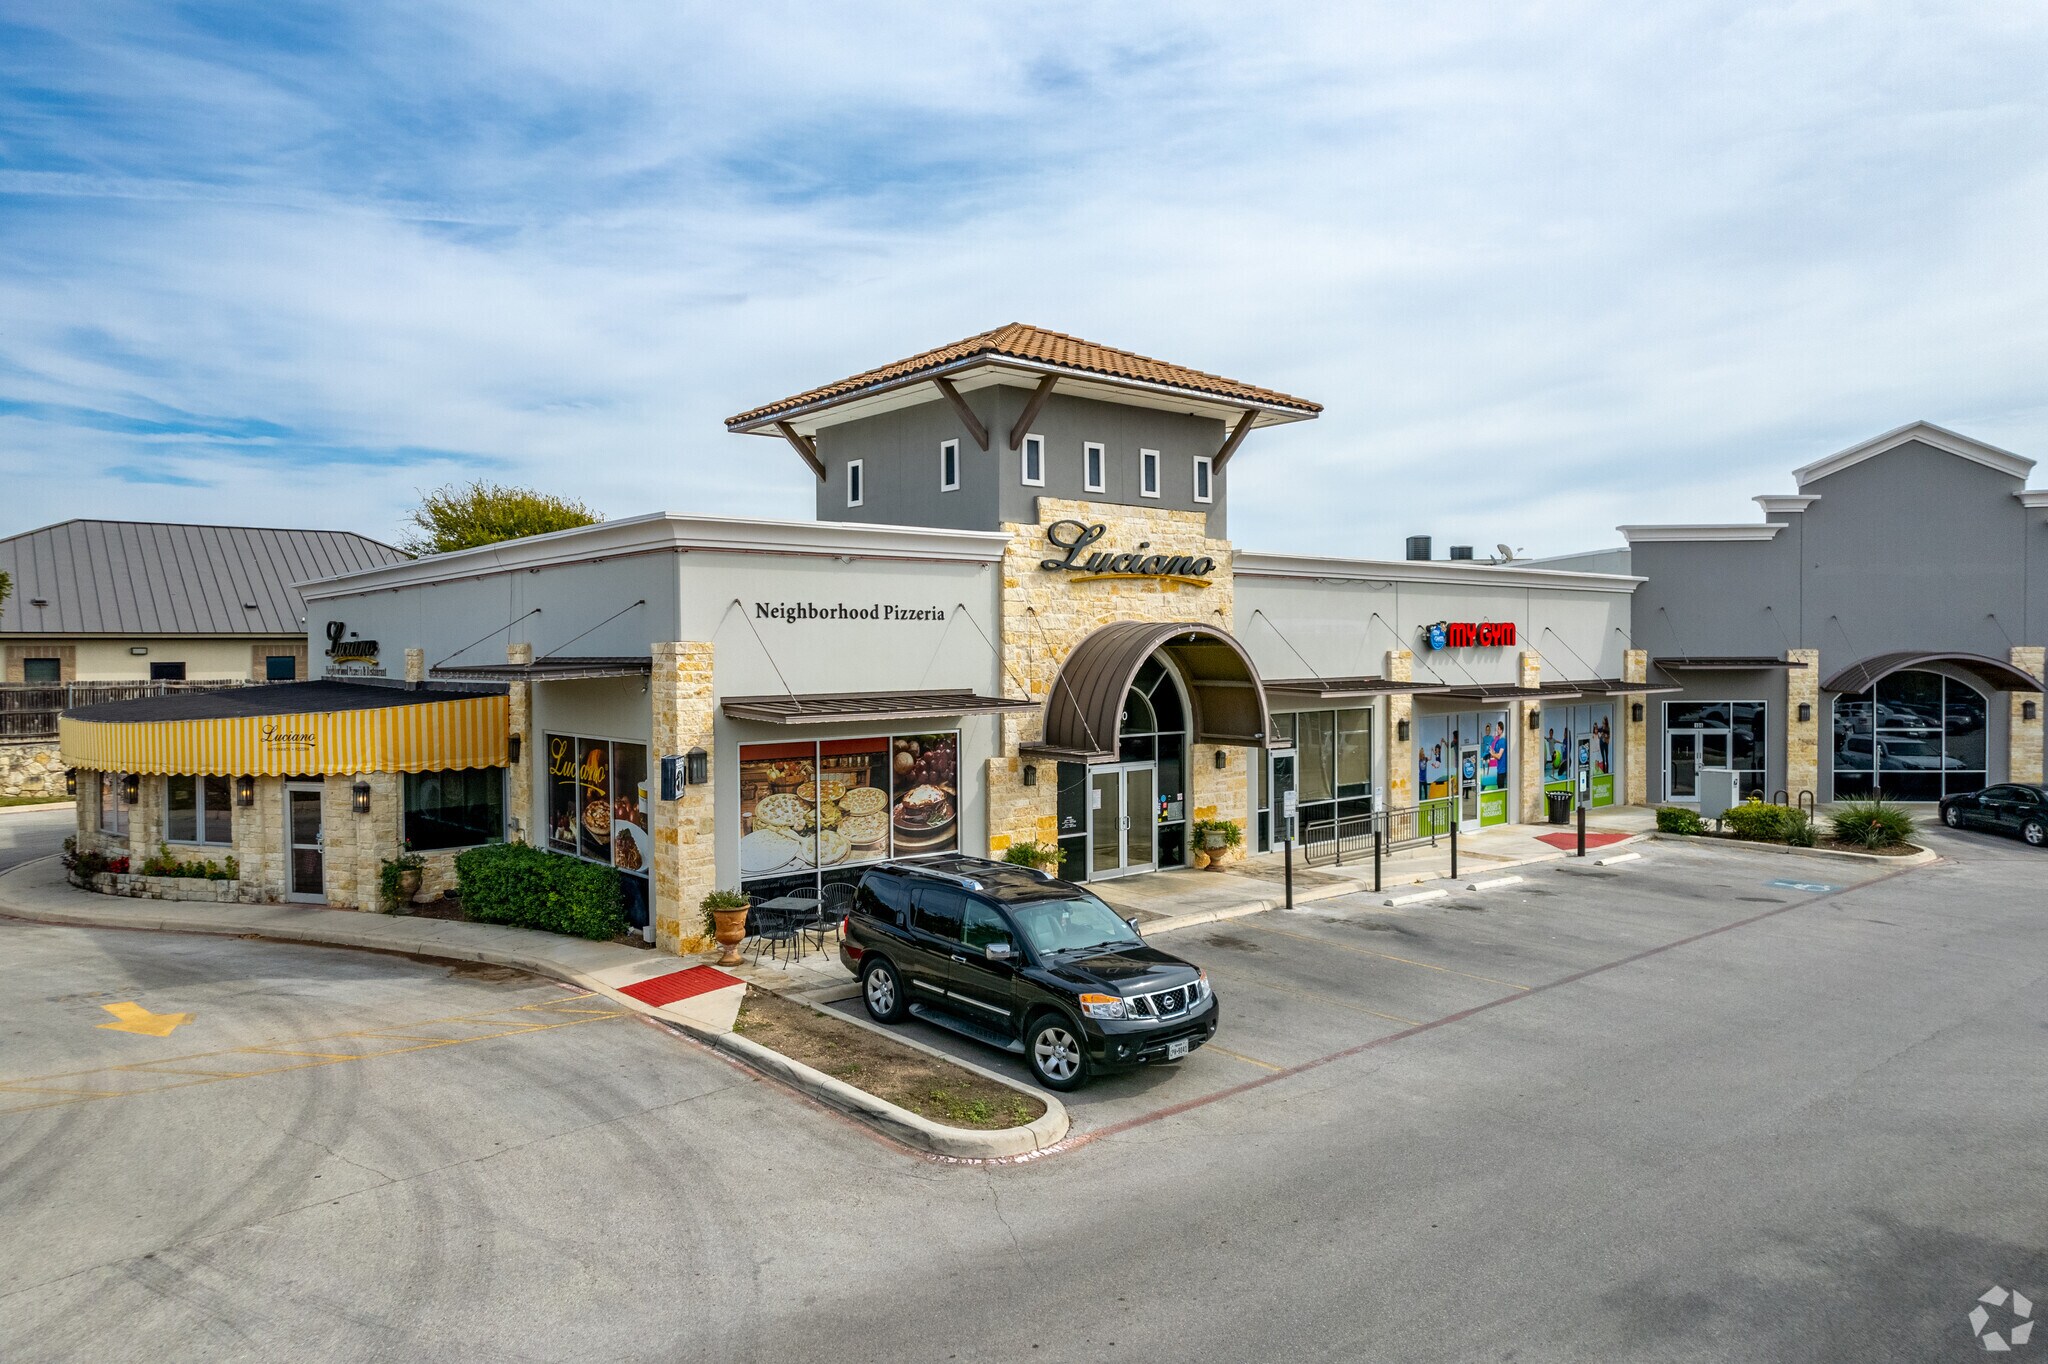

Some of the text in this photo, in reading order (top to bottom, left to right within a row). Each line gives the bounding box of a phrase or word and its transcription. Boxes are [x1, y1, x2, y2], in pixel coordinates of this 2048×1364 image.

[1040, 519, 1216, 577] Luciano
[755, 602, 945, 624] Neighborhood Pizzeria
[325, 621, 380, 657] Luciano
[260, 724, 316, 743] Luciano
[549, 737, 606, 783] Lucano
